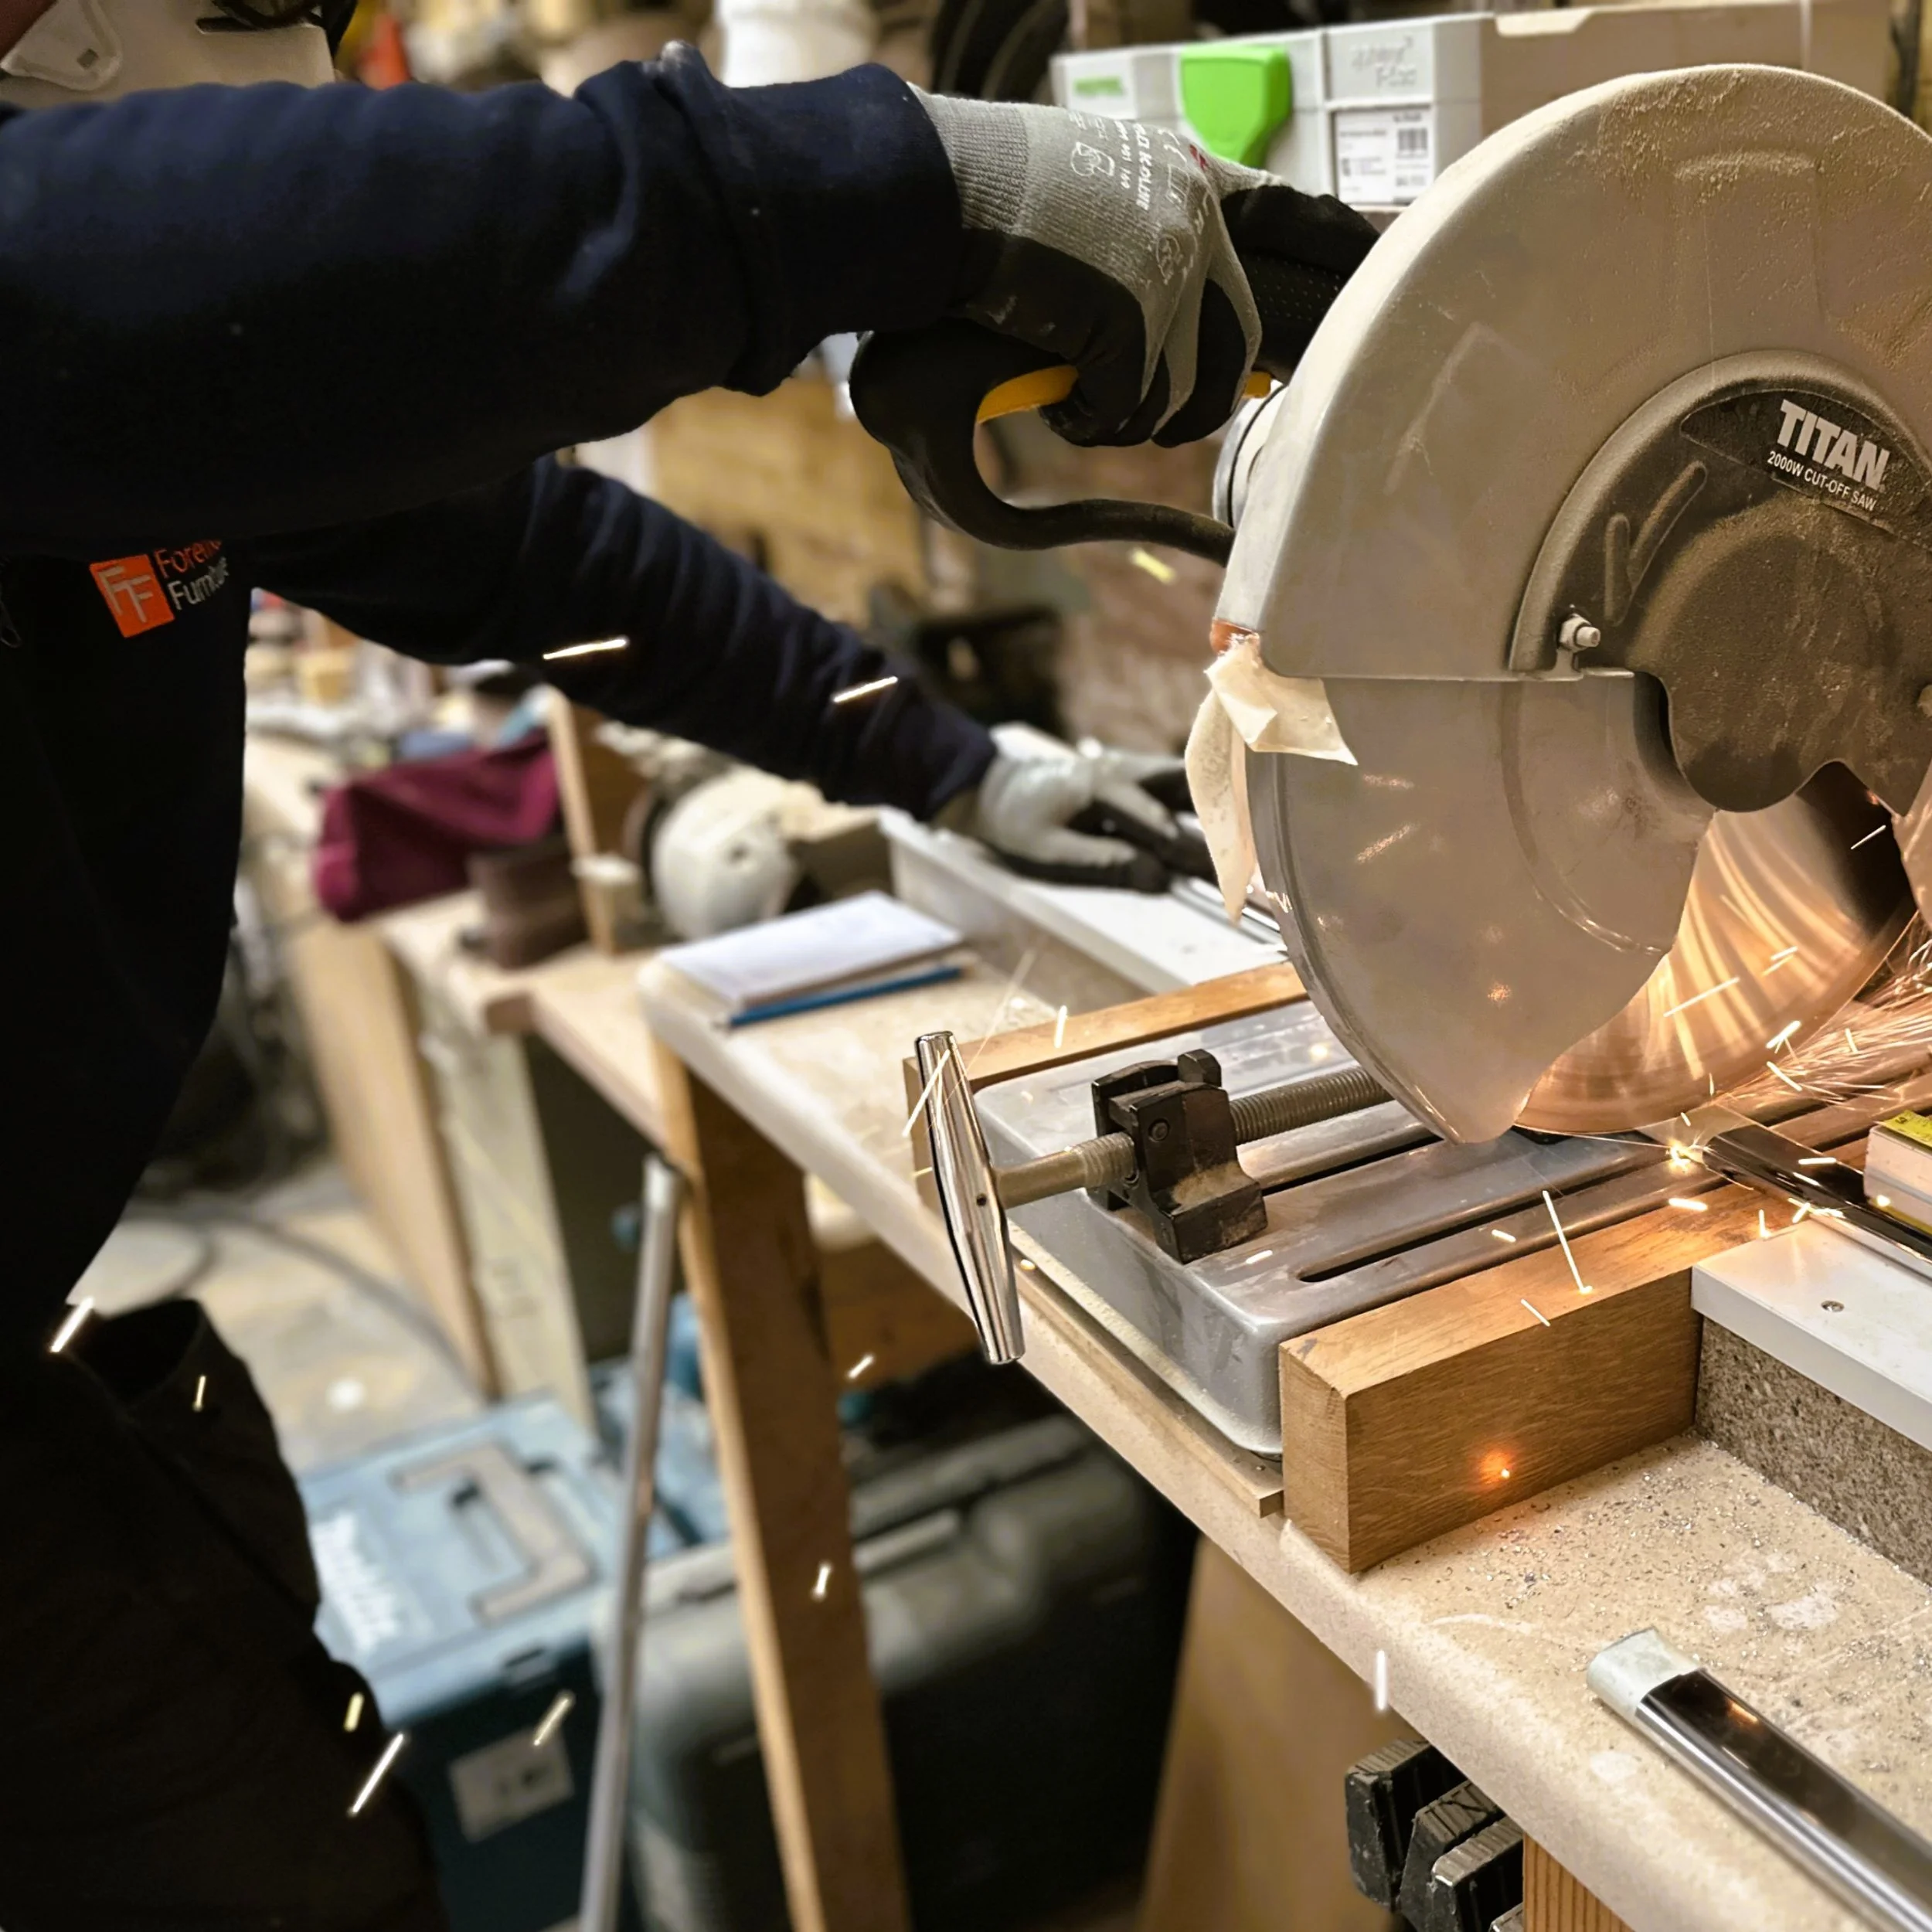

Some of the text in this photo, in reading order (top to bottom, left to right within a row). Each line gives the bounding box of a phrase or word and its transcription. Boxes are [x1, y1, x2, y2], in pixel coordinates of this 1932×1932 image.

[1767, 451, 1877, 512] 2000W CUT-OFF SAW
[1777, 399, 1890, 491] TITAN
